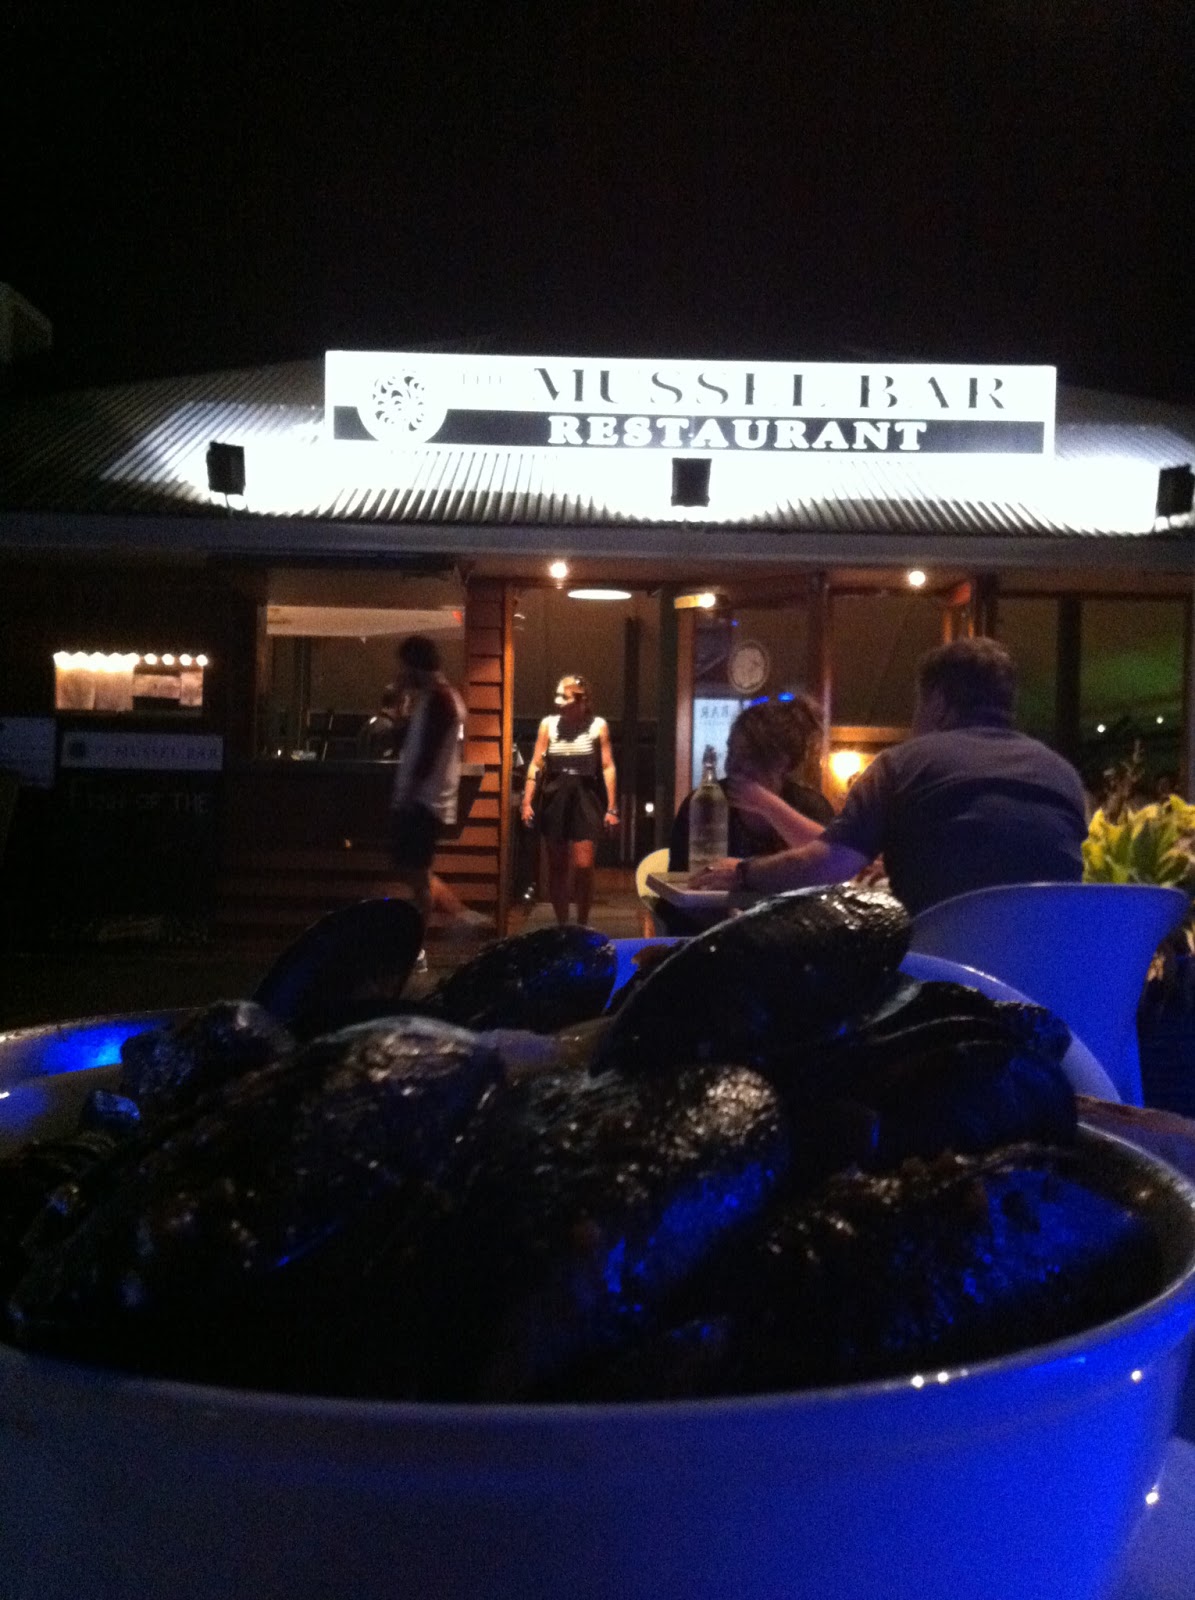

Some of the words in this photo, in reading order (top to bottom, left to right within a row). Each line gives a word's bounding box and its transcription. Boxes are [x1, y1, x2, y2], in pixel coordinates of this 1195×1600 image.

[533, 366, 827, 408] MUSSEL
[859, 373, 1005, 410] BAR
[547, 413, 927, 451] RESTAURANT
